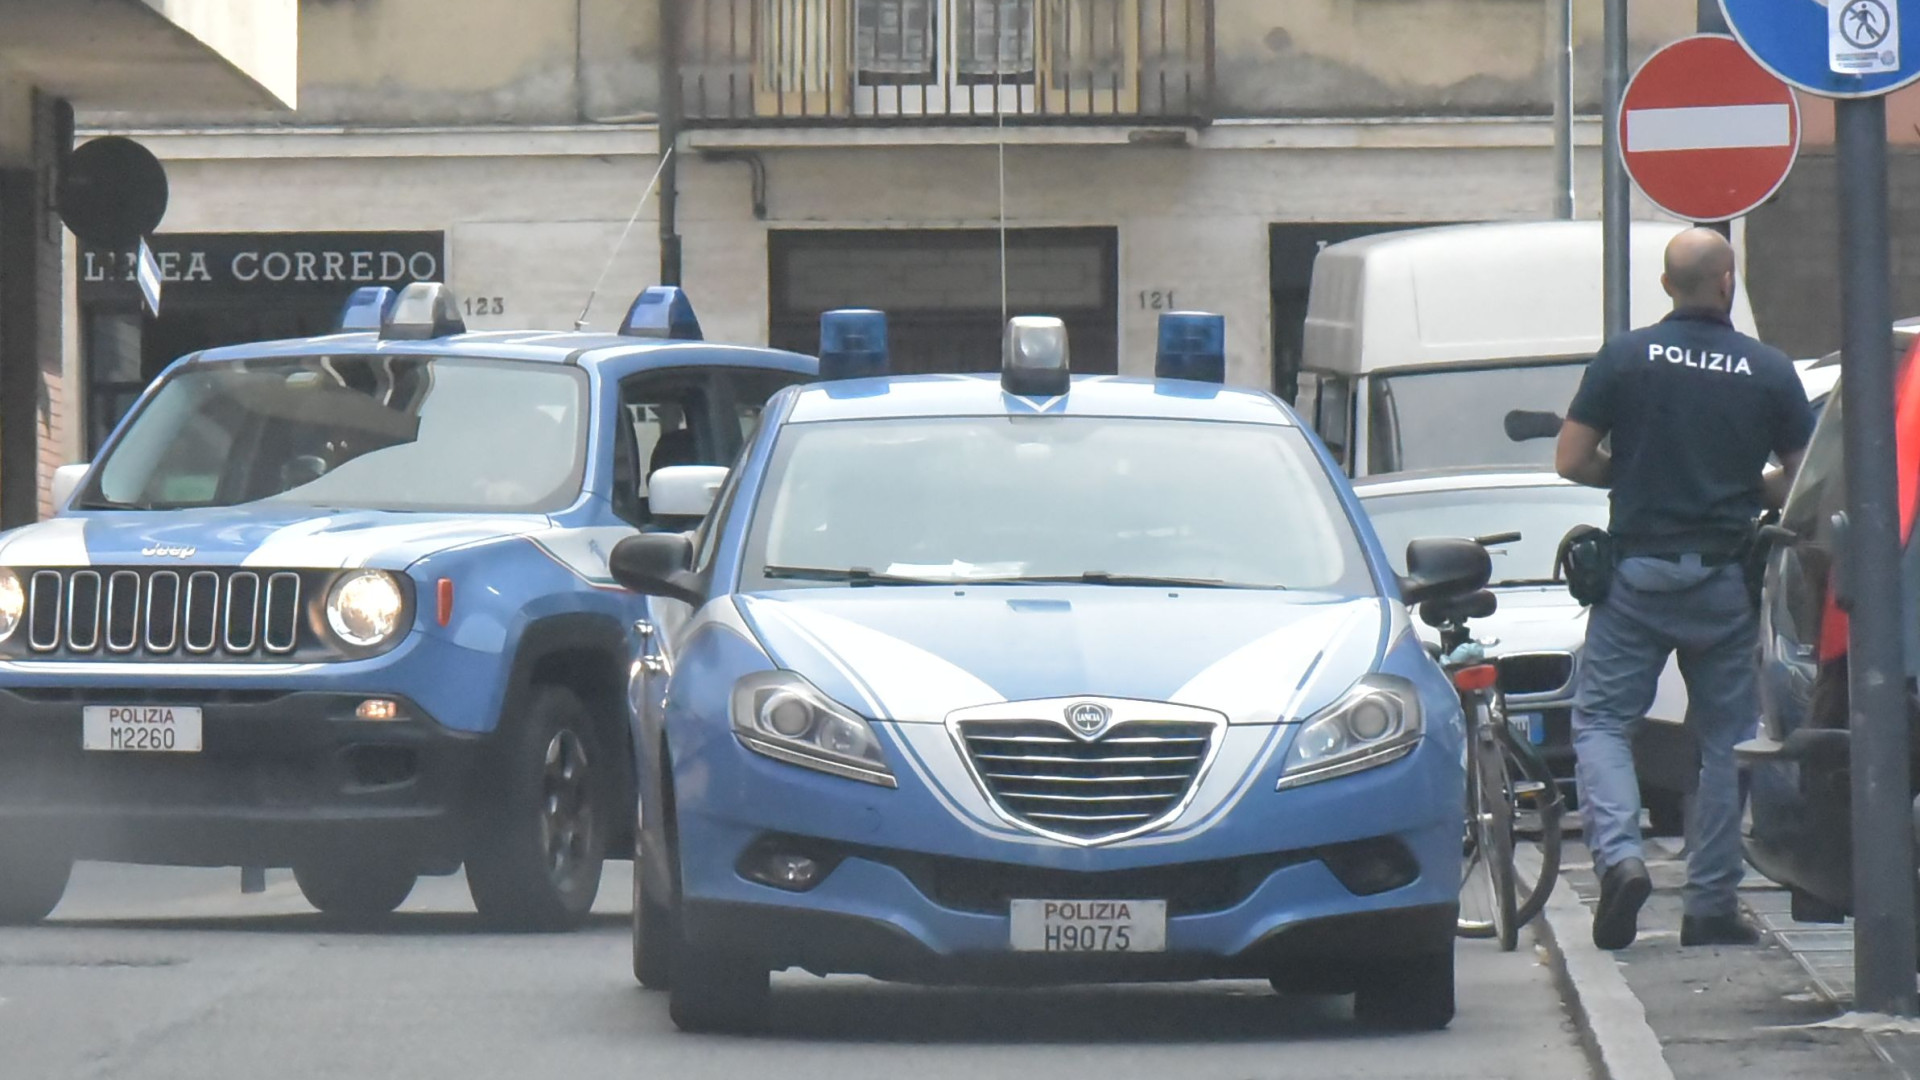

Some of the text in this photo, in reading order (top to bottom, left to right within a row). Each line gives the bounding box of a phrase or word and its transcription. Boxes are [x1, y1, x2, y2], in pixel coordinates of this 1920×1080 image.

[84, 251, 436, 281] LEA CORREDO
[464, 297, 505, 316] 123
[1139, 290, 1176, 310] 121
[1648, 343, 1752, 376] POLIZIA
[141, 542, 197, 560] Jeep
[109, 708, 175, 724] POLIZIA
[110, 727, 175, 749] M2260
[1044, 903, 1131, 920] POLIZIA
[1045, 925, 1130, 950] H9075
